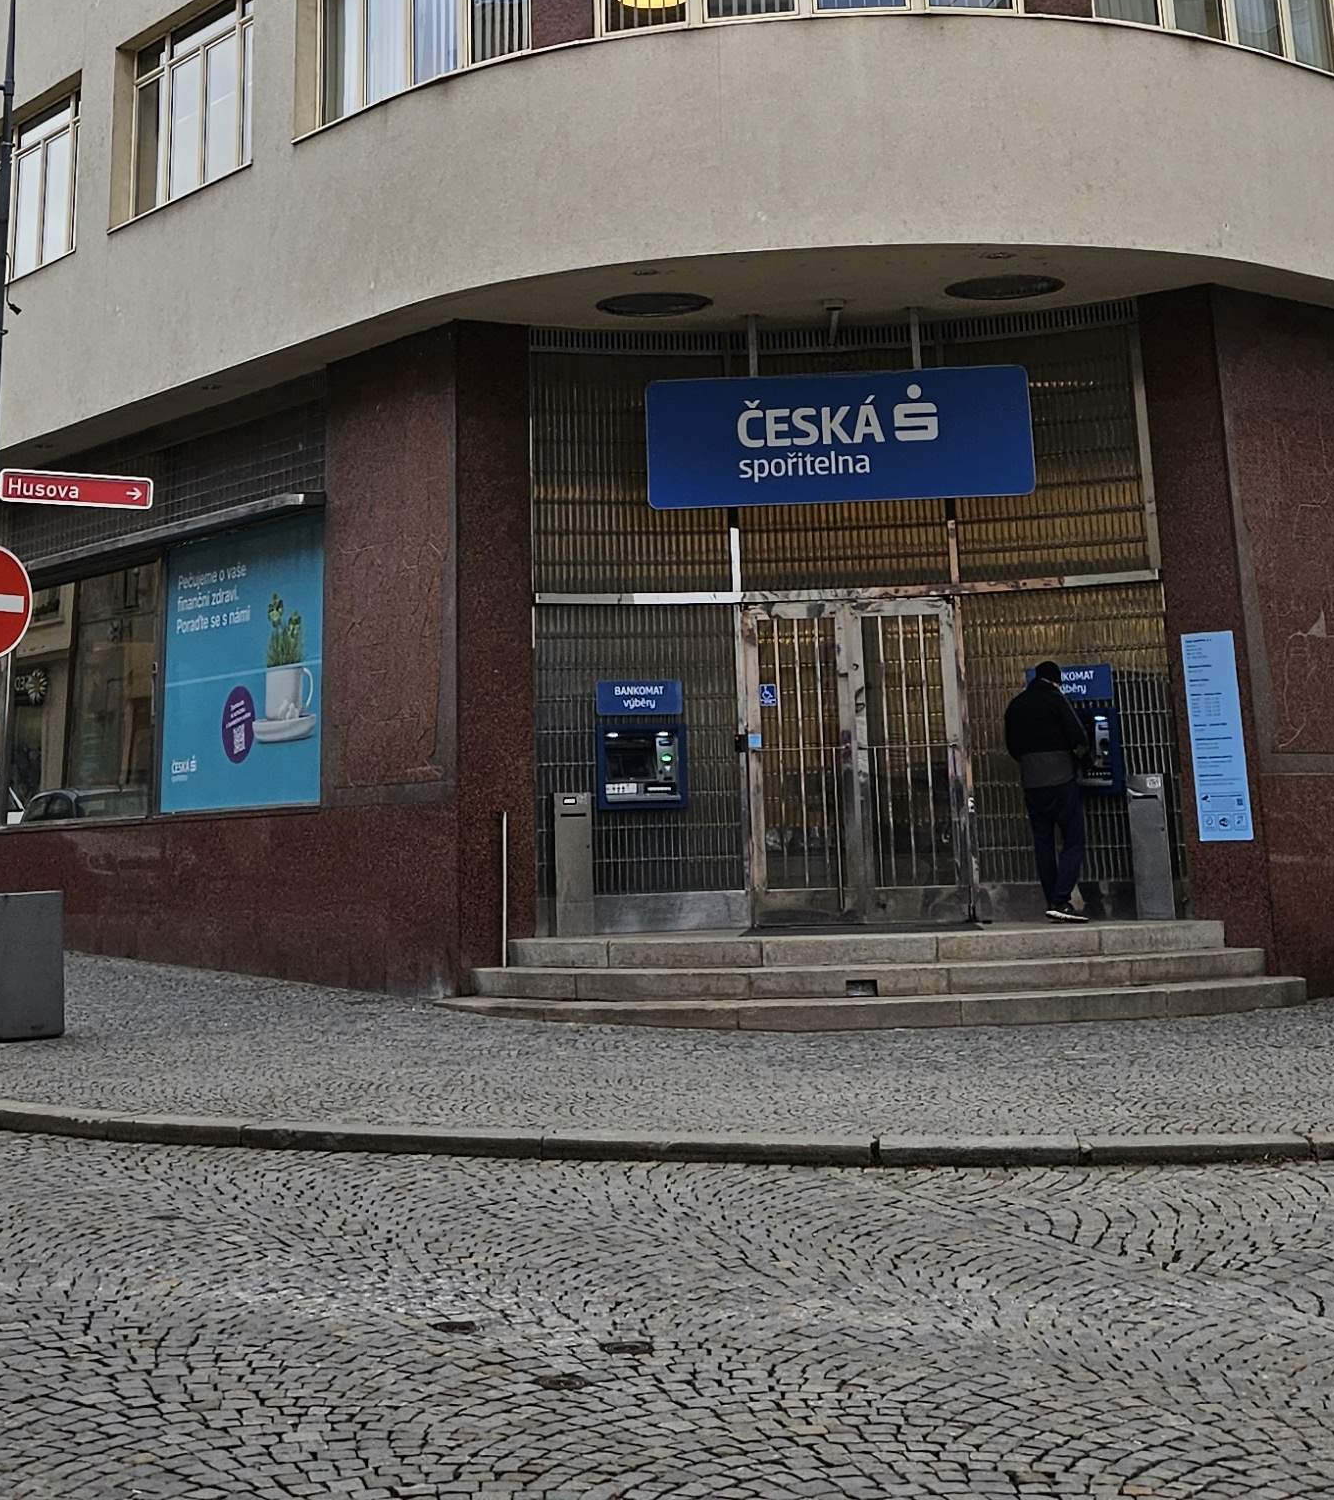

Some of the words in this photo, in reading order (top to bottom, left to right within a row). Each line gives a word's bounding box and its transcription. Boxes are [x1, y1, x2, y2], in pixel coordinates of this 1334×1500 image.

[737, 394, 886, 448] ČESKÁ
[739, 450, 871, 483] spořitelna
[8, 477, 80, 499] Husova
[178, 570, 218, 590] Pečujeme
[218, 569, 225, 582] o
[226, 561, 247, 580] vaše
[177, 590, 210, 613] finanční
[176, 614, 209, 635] Poraďte
[210, 615, 220, 629] se
[229, 604, 251, 625] námi
[1060, 670, 1094, 681] KOMAT
[614, 686, 664, 696] BANKOMAT
[622, 699, 656, 710] výběry
